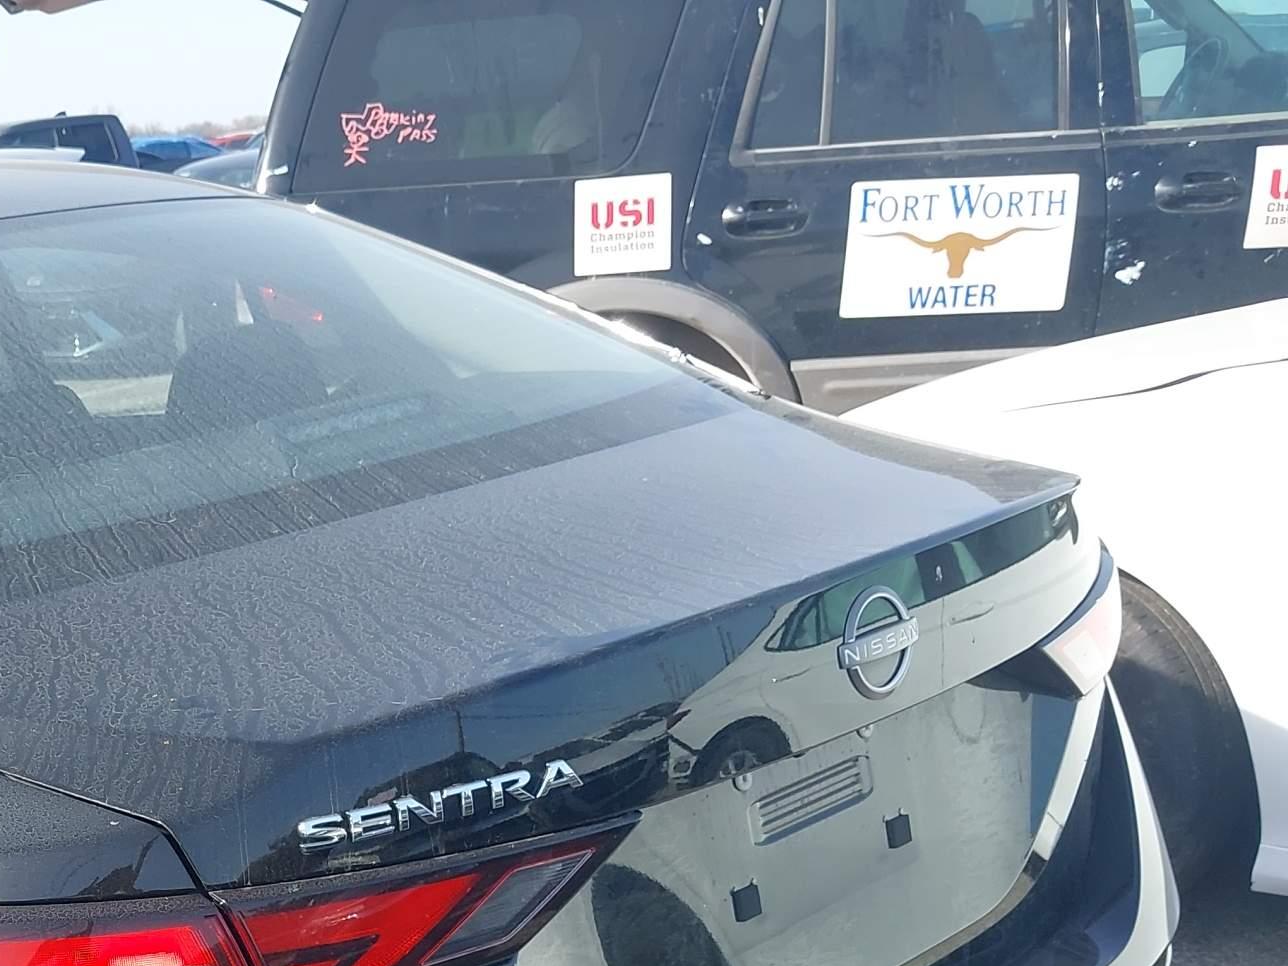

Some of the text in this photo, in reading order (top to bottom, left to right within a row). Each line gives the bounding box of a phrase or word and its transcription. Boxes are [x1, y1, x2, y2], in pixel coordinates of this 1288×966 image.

[591, 197, 655, 230] USI
[859, 184, 1067, 223] FORT WORTH
[590, 230, 655, 242] Champion
[590, 241, 655, 254] Insulation
[908, 283, 997, 309] WATER
[844, 619, 919, 665] NISSAN
[297, 759, 584, 854] SENTRA
